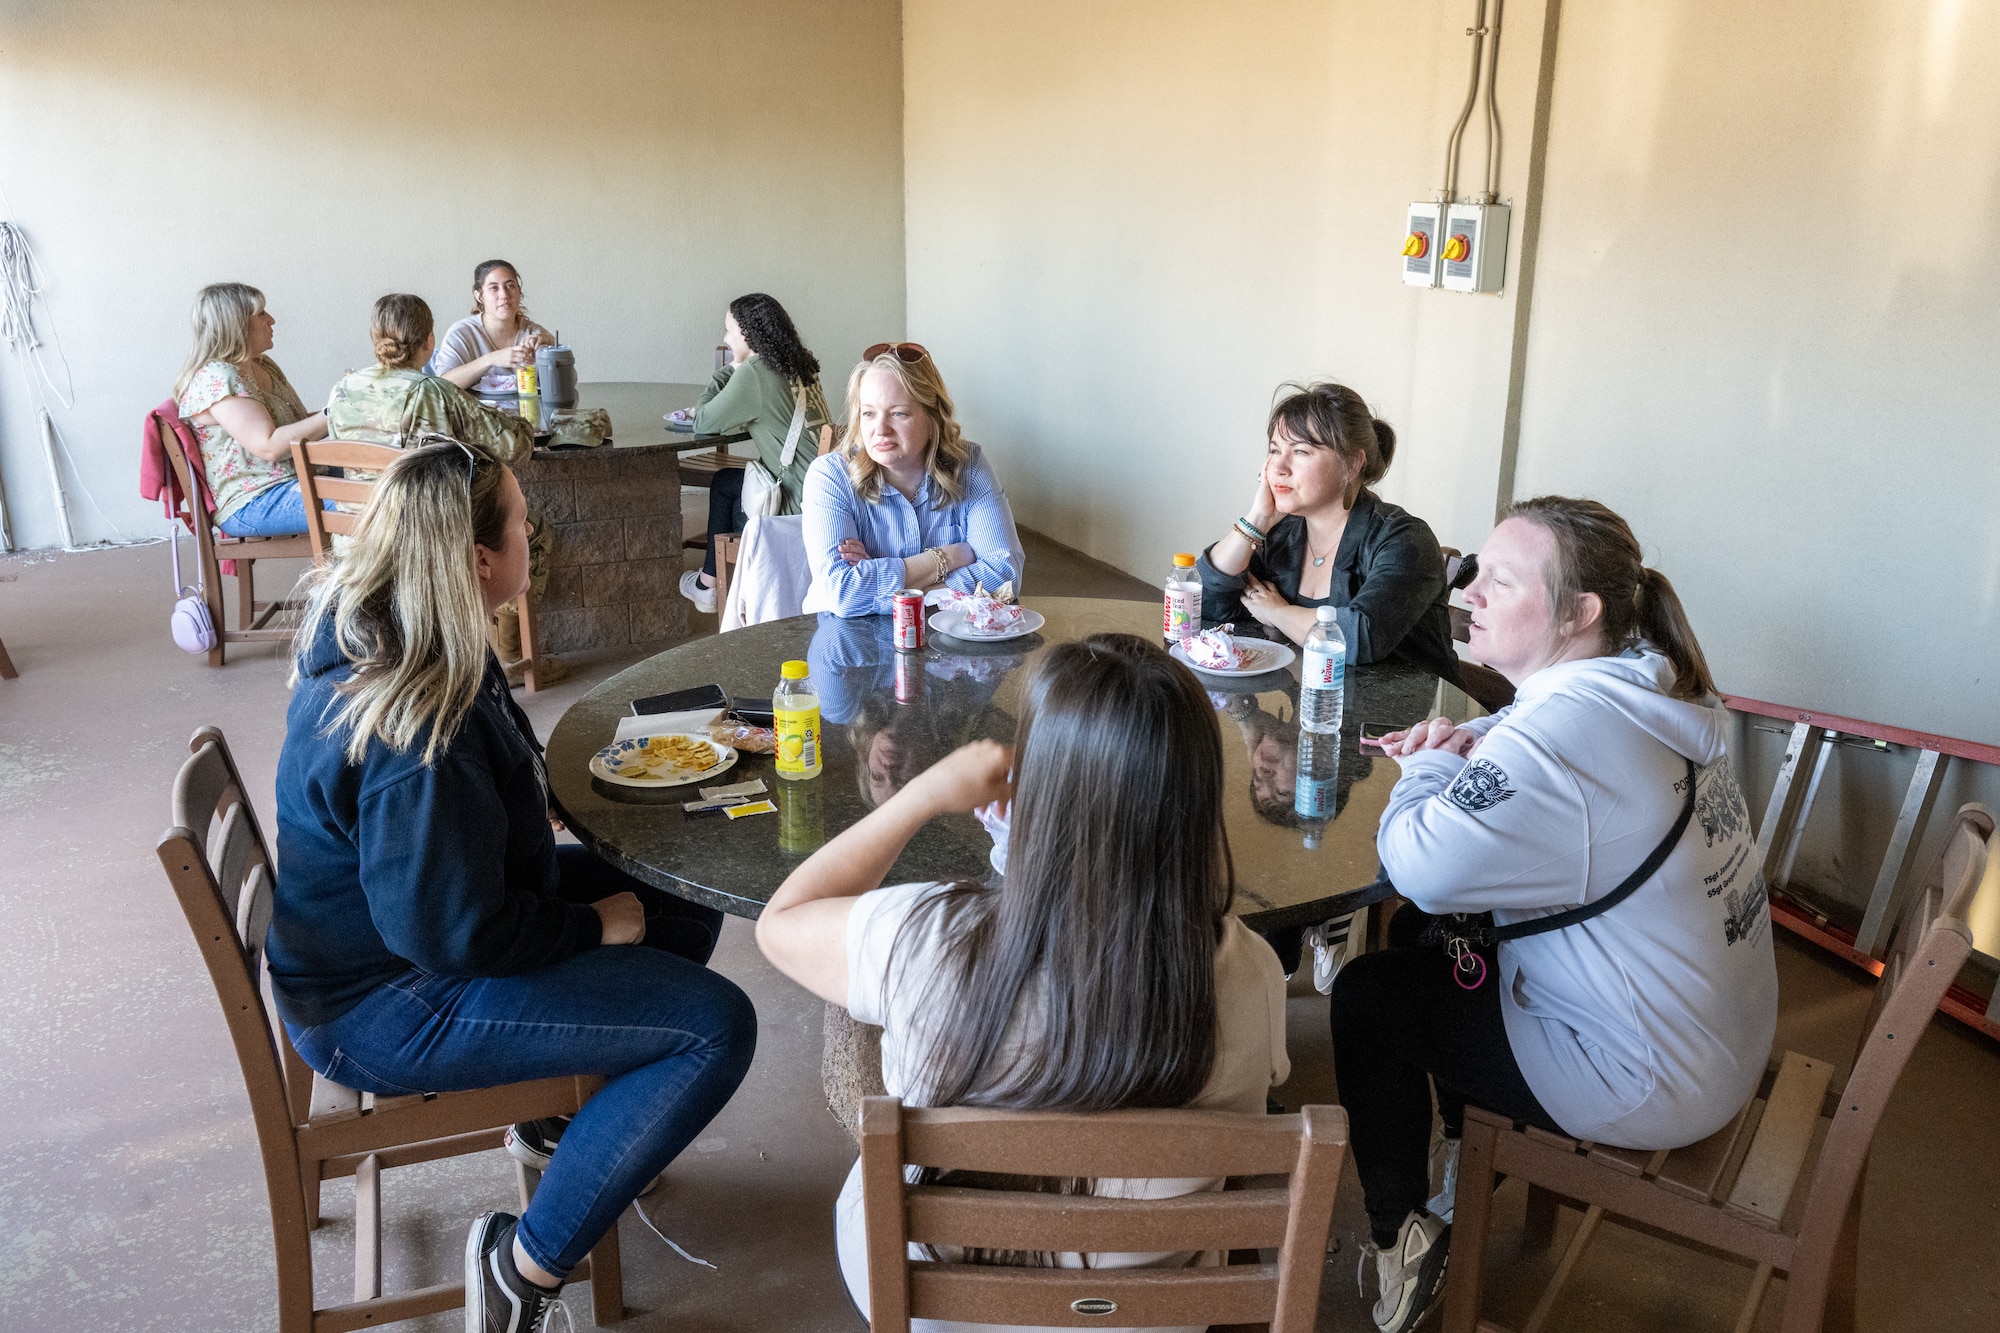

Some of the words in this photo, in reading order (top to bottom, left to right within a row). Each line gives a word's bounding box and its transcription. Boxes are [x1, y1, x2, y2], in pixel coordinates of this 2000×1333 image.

[1323, 658, 1333, 683] Wawa
[1481, 761, 1503, 778] 2T2
[1703, 871, 1719, 885] TSgt
[1707, 884, 1723, 898] SSgt
